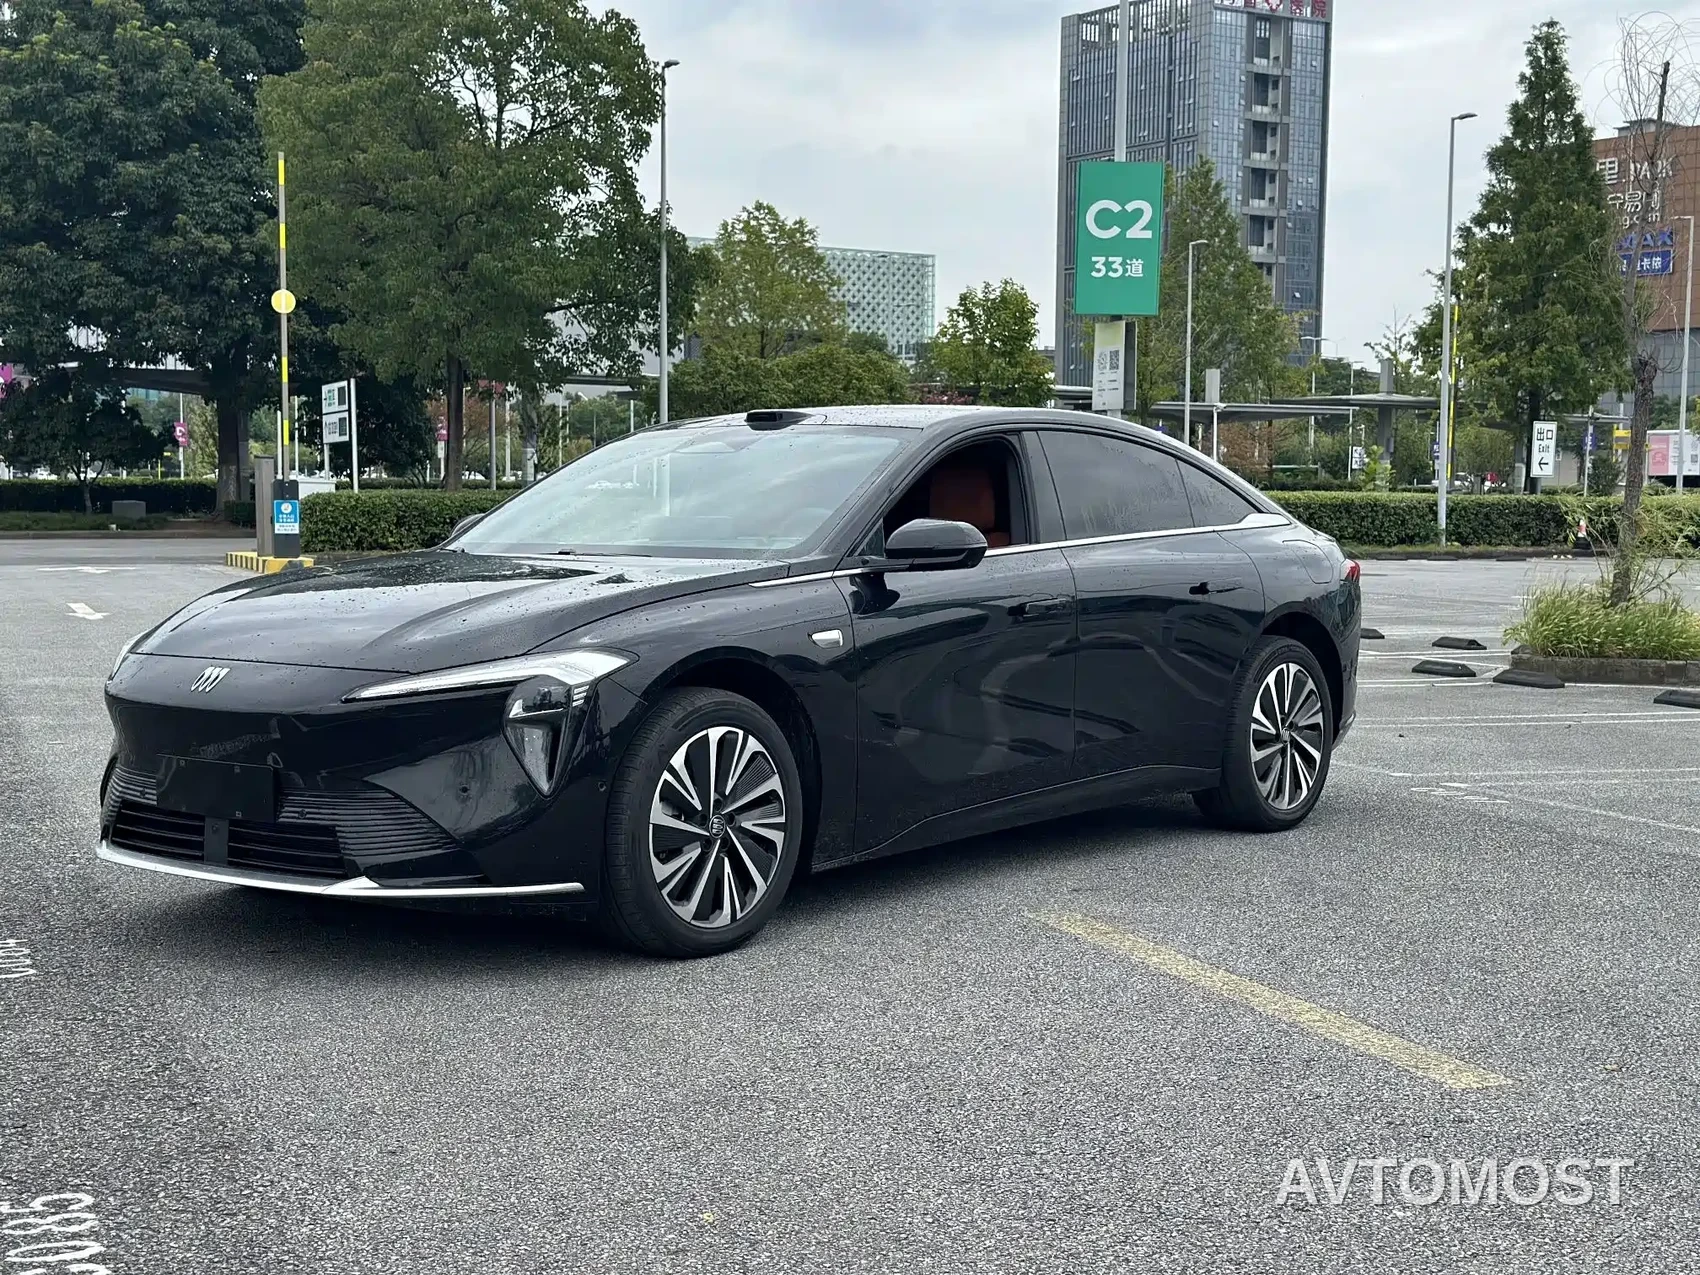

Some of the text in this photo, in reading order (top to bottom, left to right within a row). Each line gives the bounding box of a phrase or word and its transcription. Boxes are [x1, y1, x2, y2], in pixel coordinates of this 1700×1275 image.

[1086, 200, 1152, 238] C2
[1091, 256, 1144, 278] 33道
[1537, 428, 1553, 440] 出口
